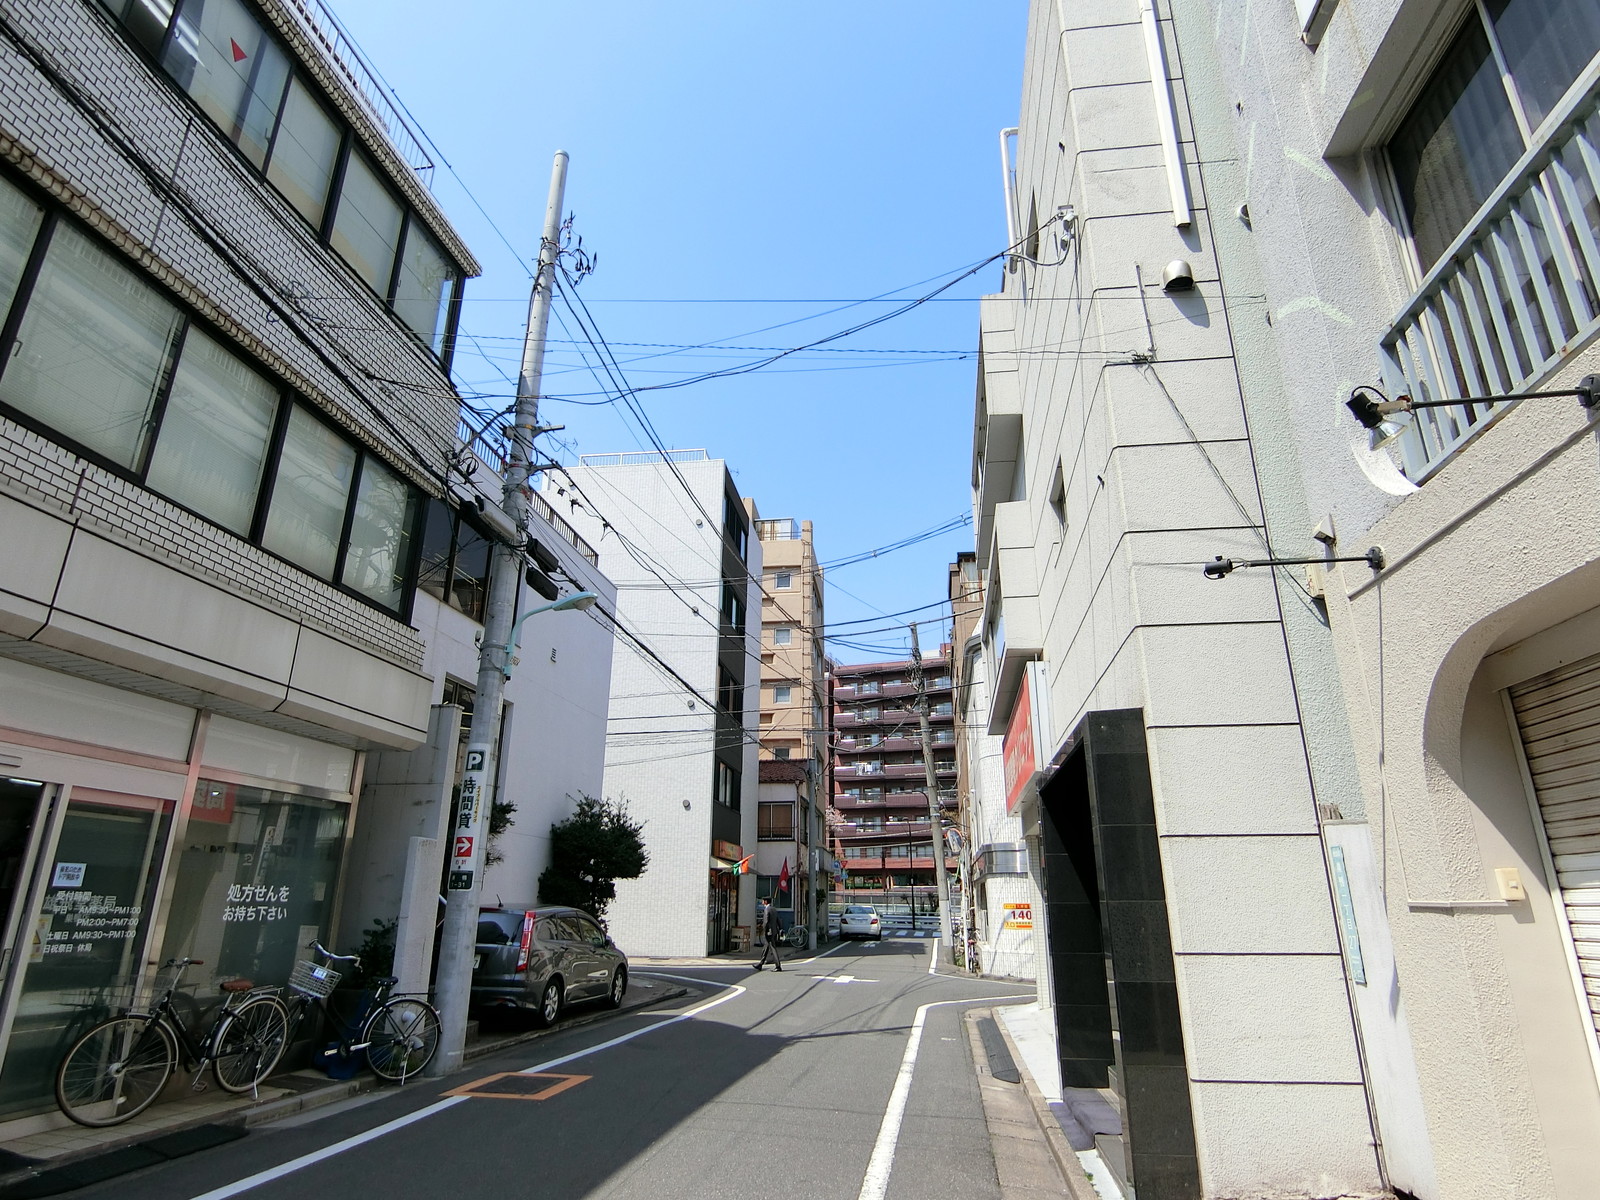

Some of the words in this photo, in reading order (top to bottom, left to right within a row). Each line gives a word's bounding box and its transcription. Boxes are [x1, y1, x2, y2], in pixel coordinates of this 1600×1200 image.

[468, 752, 482, 770] P
[458, 776, 477, 829] 時間貸
[56, 891, 92, 901] 受付時間
[226, 883, 290, 902] 処方せんを
[53, 905, 68, 914] 平日
[222, 905, 287, 921] お持ち下さい
[46, 931, 69, 940] 土曜日
[43, 944, 73, 953] 日祝祭日
[77, 943, 93, 952] 休局
